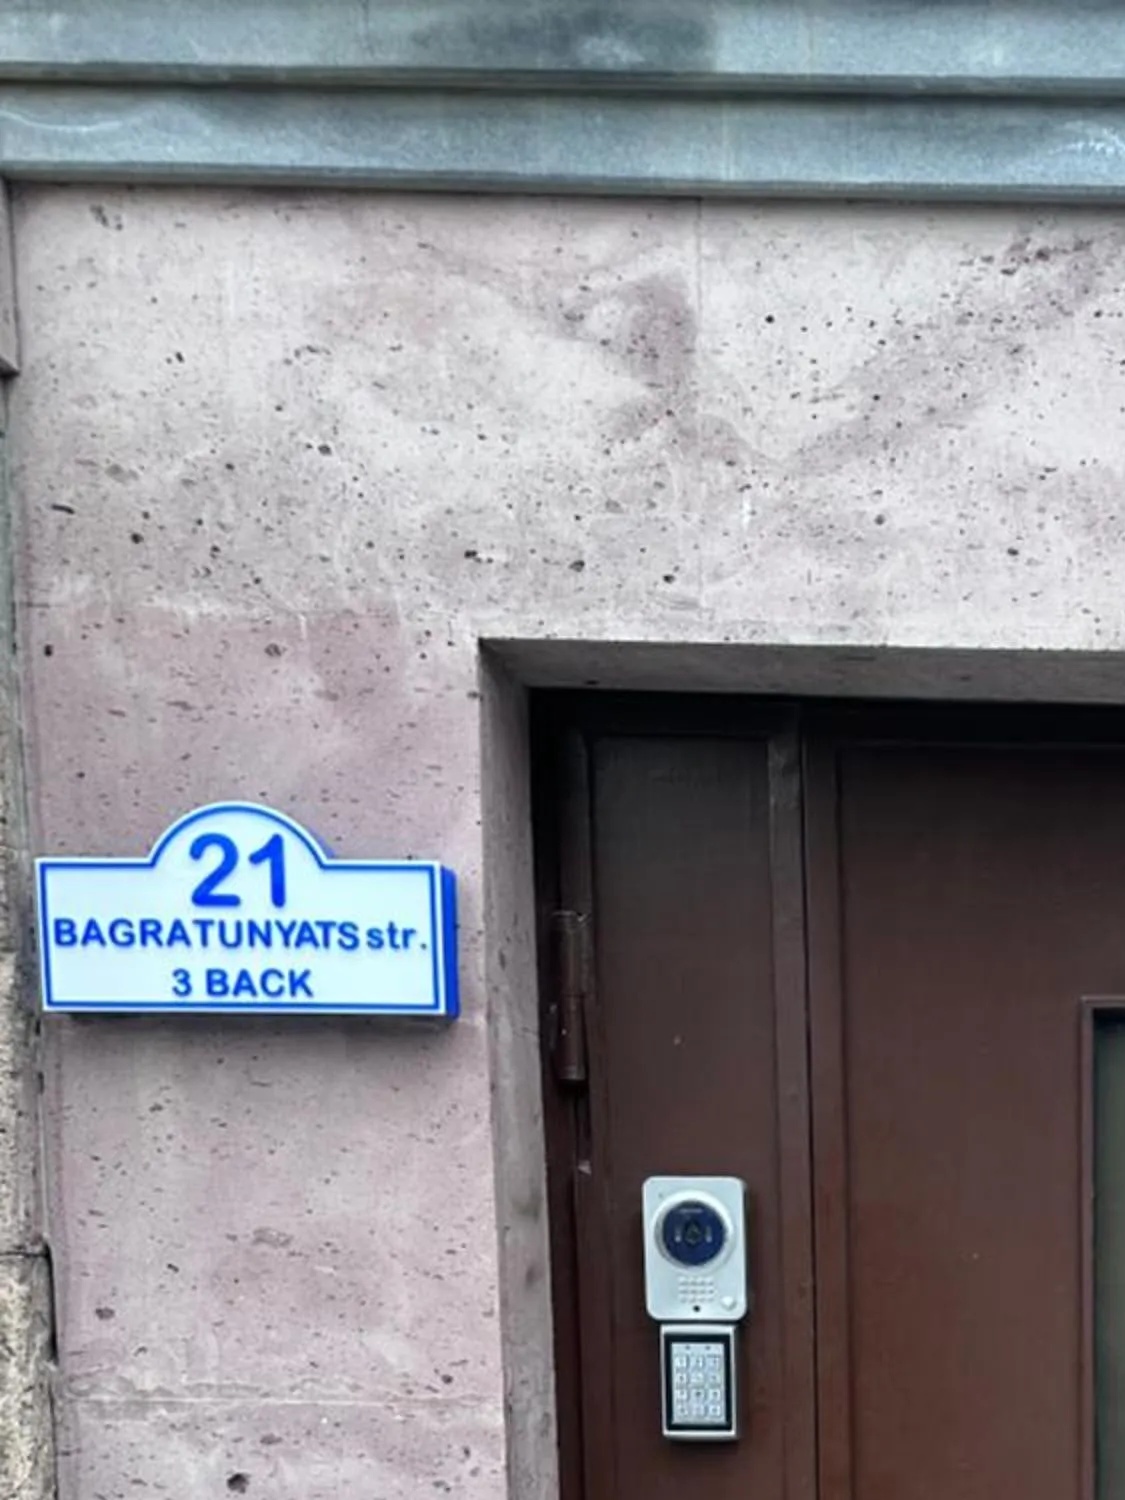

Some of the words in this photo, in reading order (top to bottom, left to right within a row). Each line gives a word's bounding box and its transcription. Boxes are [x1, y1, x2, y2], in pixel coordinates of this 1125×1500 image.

[189, 833, 286, 908] 21
[54, 918, 360, 951] BAGRATUNYATS
[172, 968, 193, 998] 3
[205, 968, 314, 998] BACK
